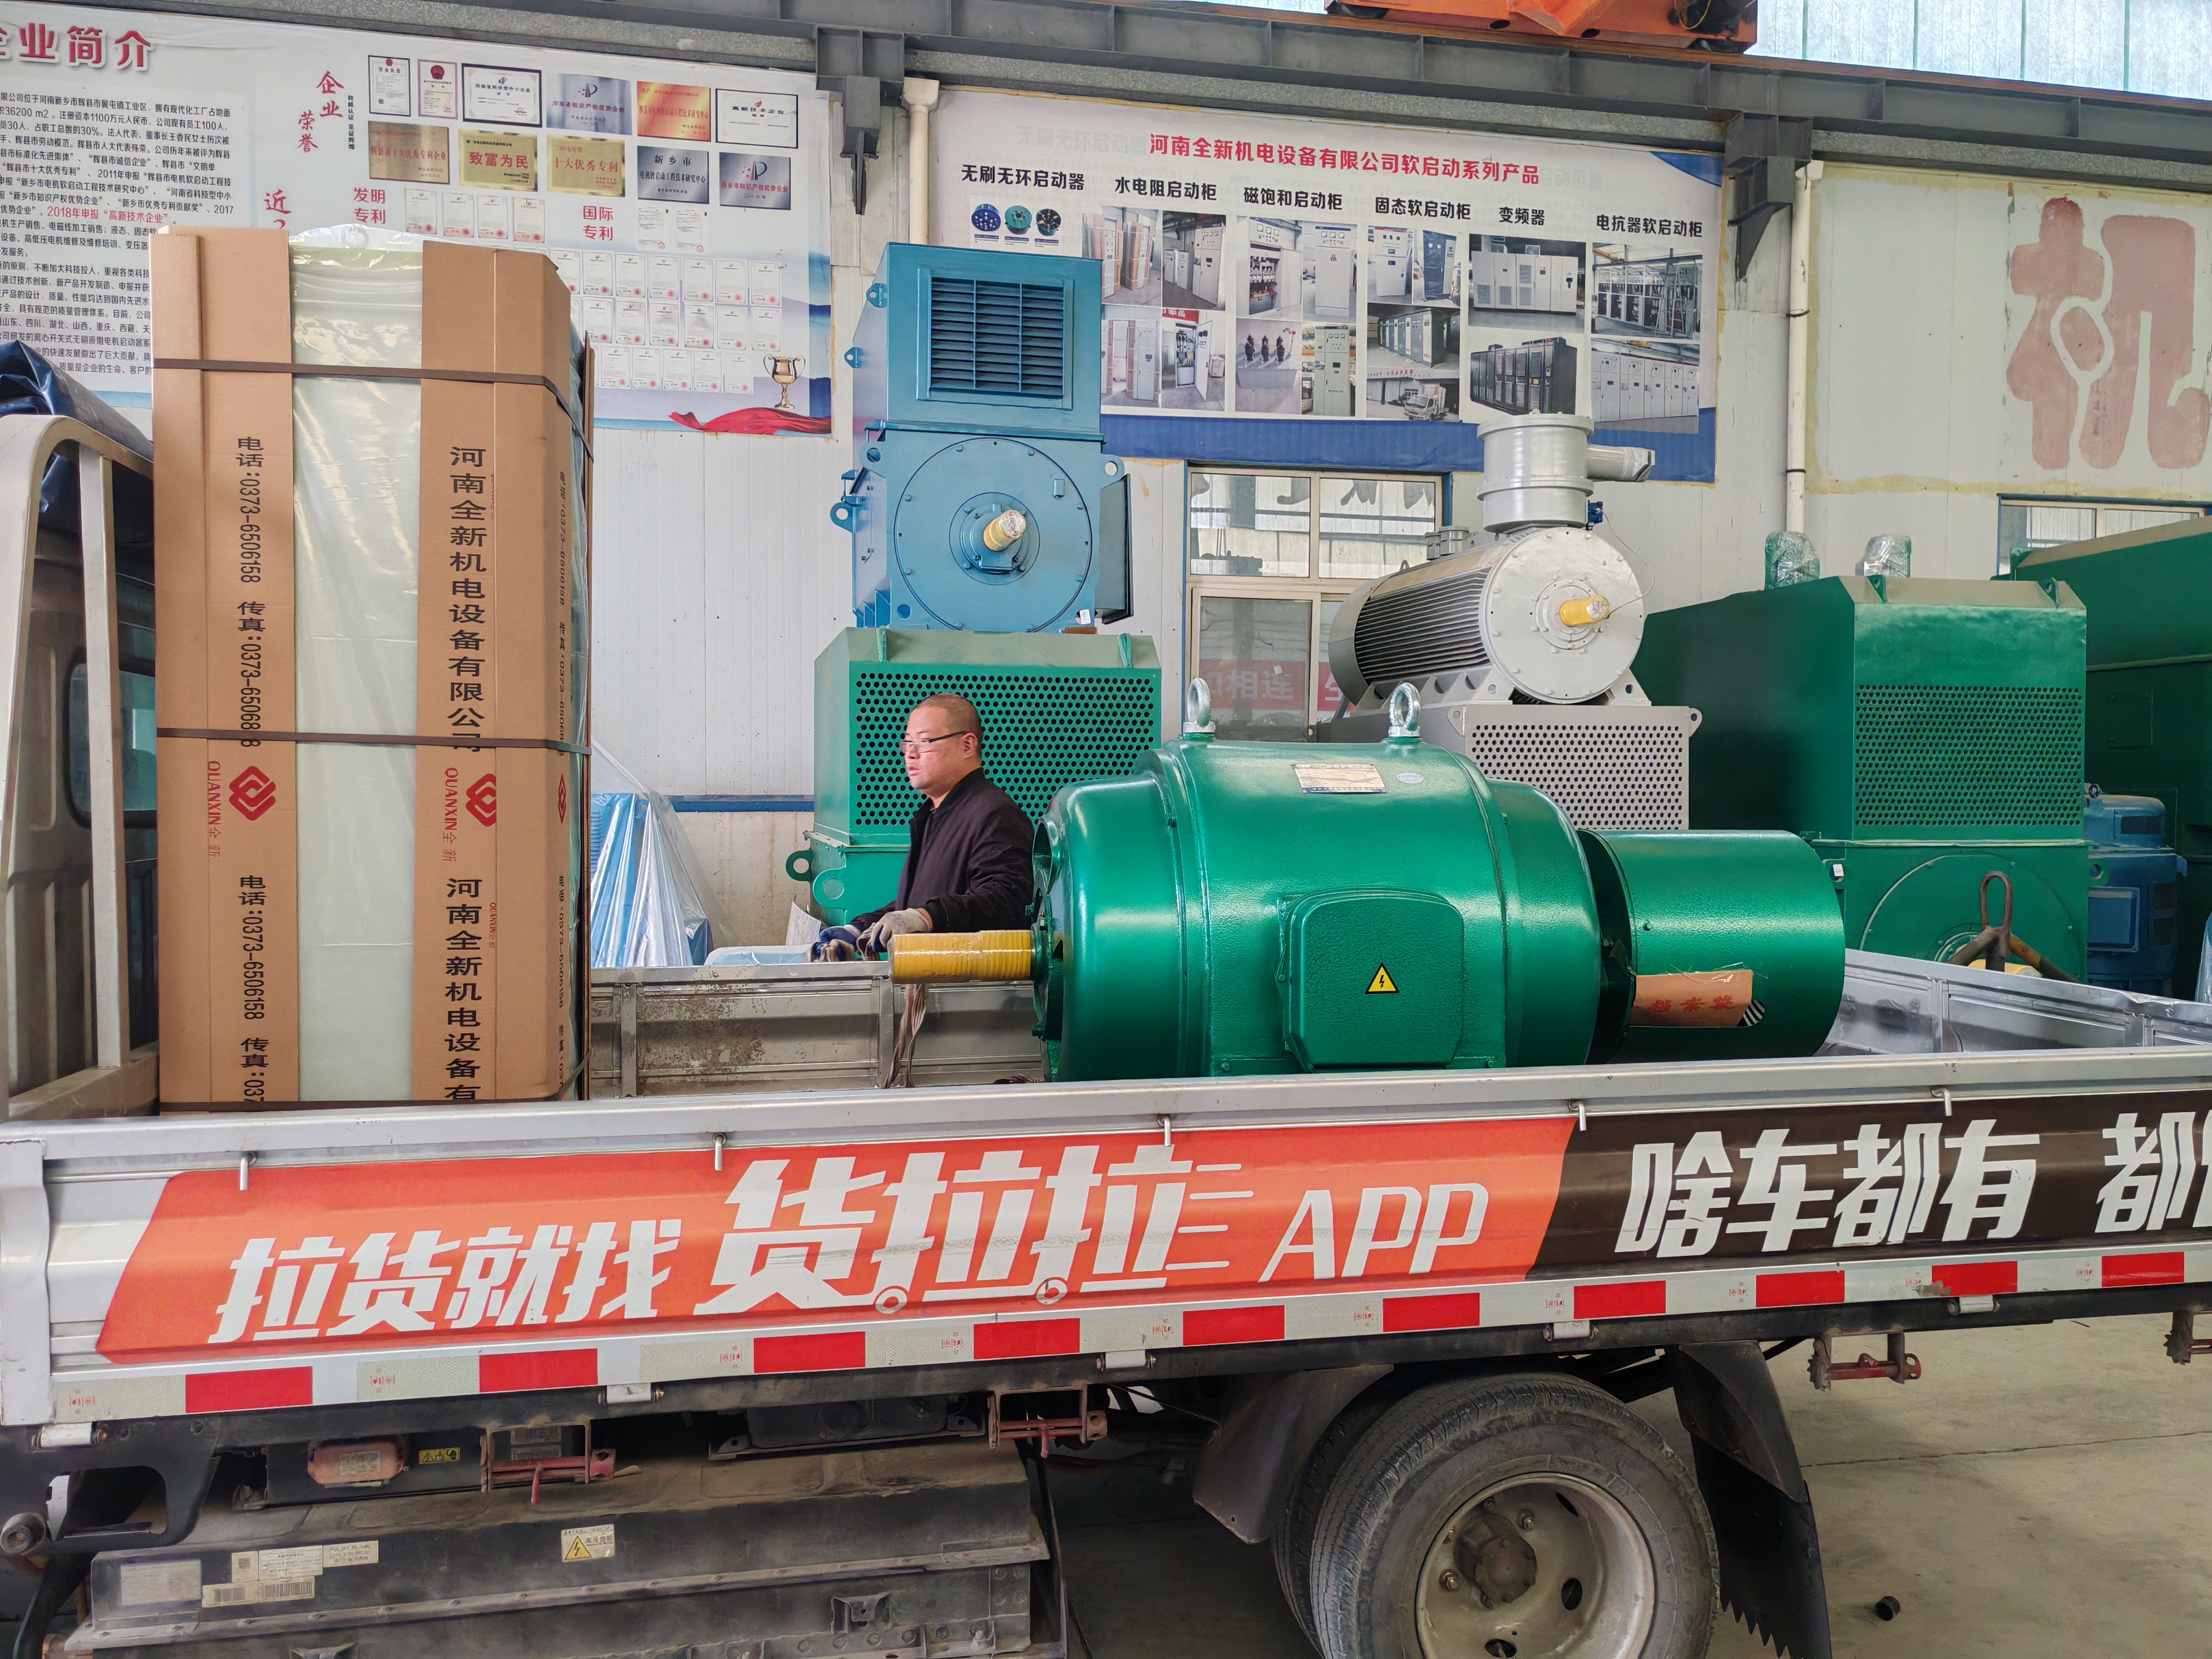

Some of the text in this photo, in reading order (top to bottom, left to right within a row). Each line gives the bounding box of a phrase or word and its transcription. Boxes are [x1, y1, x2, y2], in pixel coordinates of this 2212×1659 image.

[0, 23, 151, 68] 业简介
[315, 70, 345, 118] 企业
[297, 110, 319, 153] 荣誉
[468, 152, 529, 169] 致富为民
[554, 157, 618, 172] 十大优秀专利
[654, 154, 692, 166] 新乡市
[1150, 133, 1539, 185] 河南全新机电设备有限公司软启动系列产品
[353, 187, 385, 204] 发明
[961, 164, 1703, 238] 无刷无环启动器 水电阻启动柜 磁饱和启动柜 固态软启动柜 变频器 电抗器软启动柜
[354, 207, 386, 224] 专利
[583, 206, 613, 221] 国际
[583, 225, 613, 241] 专利
[0, 247, 29, 257] 发服务。
[0, 275, 150, 292] 通过技术创新，新产品开发制造、申报并获
[0, 289, 150, 306] 产品的设计，质量、性能均达到国内先进水
[0, 303, 151, 320] 全，具有规范的质量管理体系。目前，公司
[0, 317, 150, 334] 山东、四川、湖北、山西、重庆、西藏、天
[0, 331, 150, 348] 司研发的离心开关式无刷液阻电机启动器系
[237, 602, 266, 747] 传真:0373-650688
[207, 760, 221, 825] QUANXIN
[443, 767, 458, 831] QUANXIN
[1614, 1111, 2212, 1258] 啥车都有 都
[208, 1145, 1489, 1344] 拉货就找 货拉拉 APP
